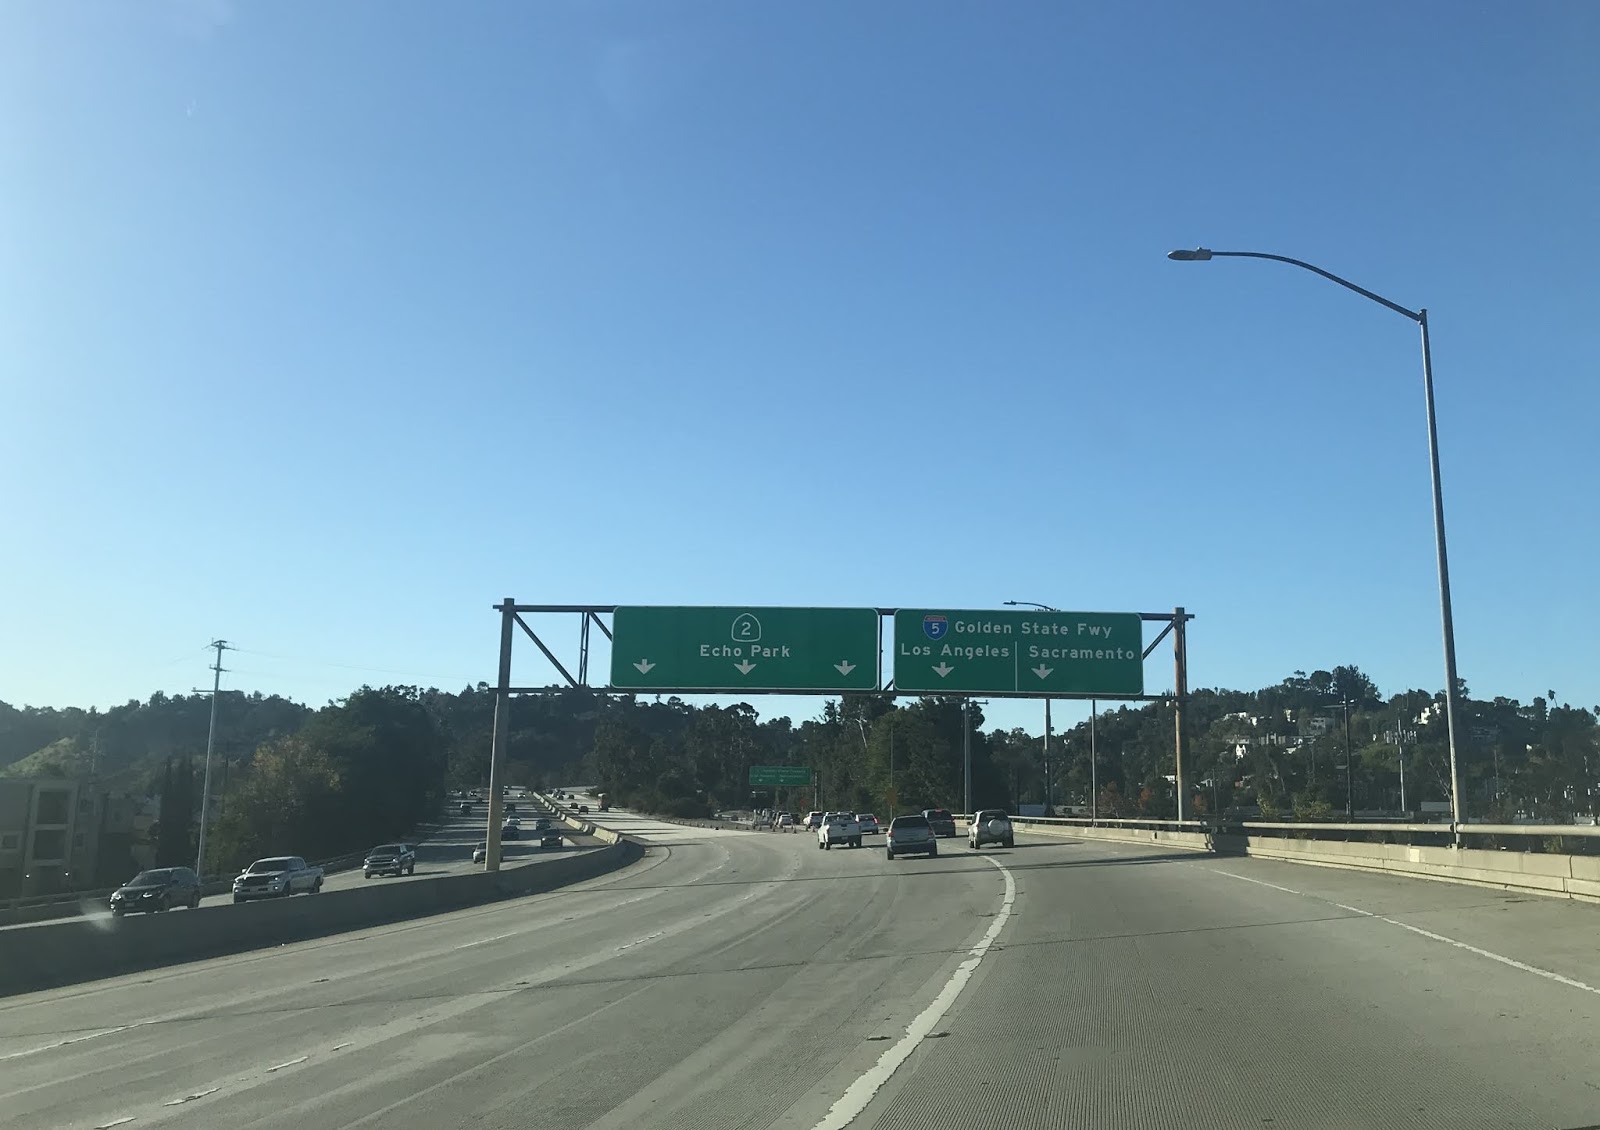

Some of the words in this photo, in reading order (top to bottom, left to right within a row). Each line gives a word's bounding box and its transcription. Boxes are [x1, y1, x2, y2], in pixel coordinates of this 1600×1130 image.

[741, 622, 751, 635] 2
[932, 623, 940, 635] 5
[955, 621, 1012, 634] Golden
[1021, 622, 1069, 635] State
[1078, 624, 1112, 638] Fwy
[700, 645, 742, 657] Echo
[751, 645, 790, 658] Park
[901, 643, 931, 656] Los
[941, 644, 1010, 660] Angeles
[1029, 645, 1135, 660] Sacramento
